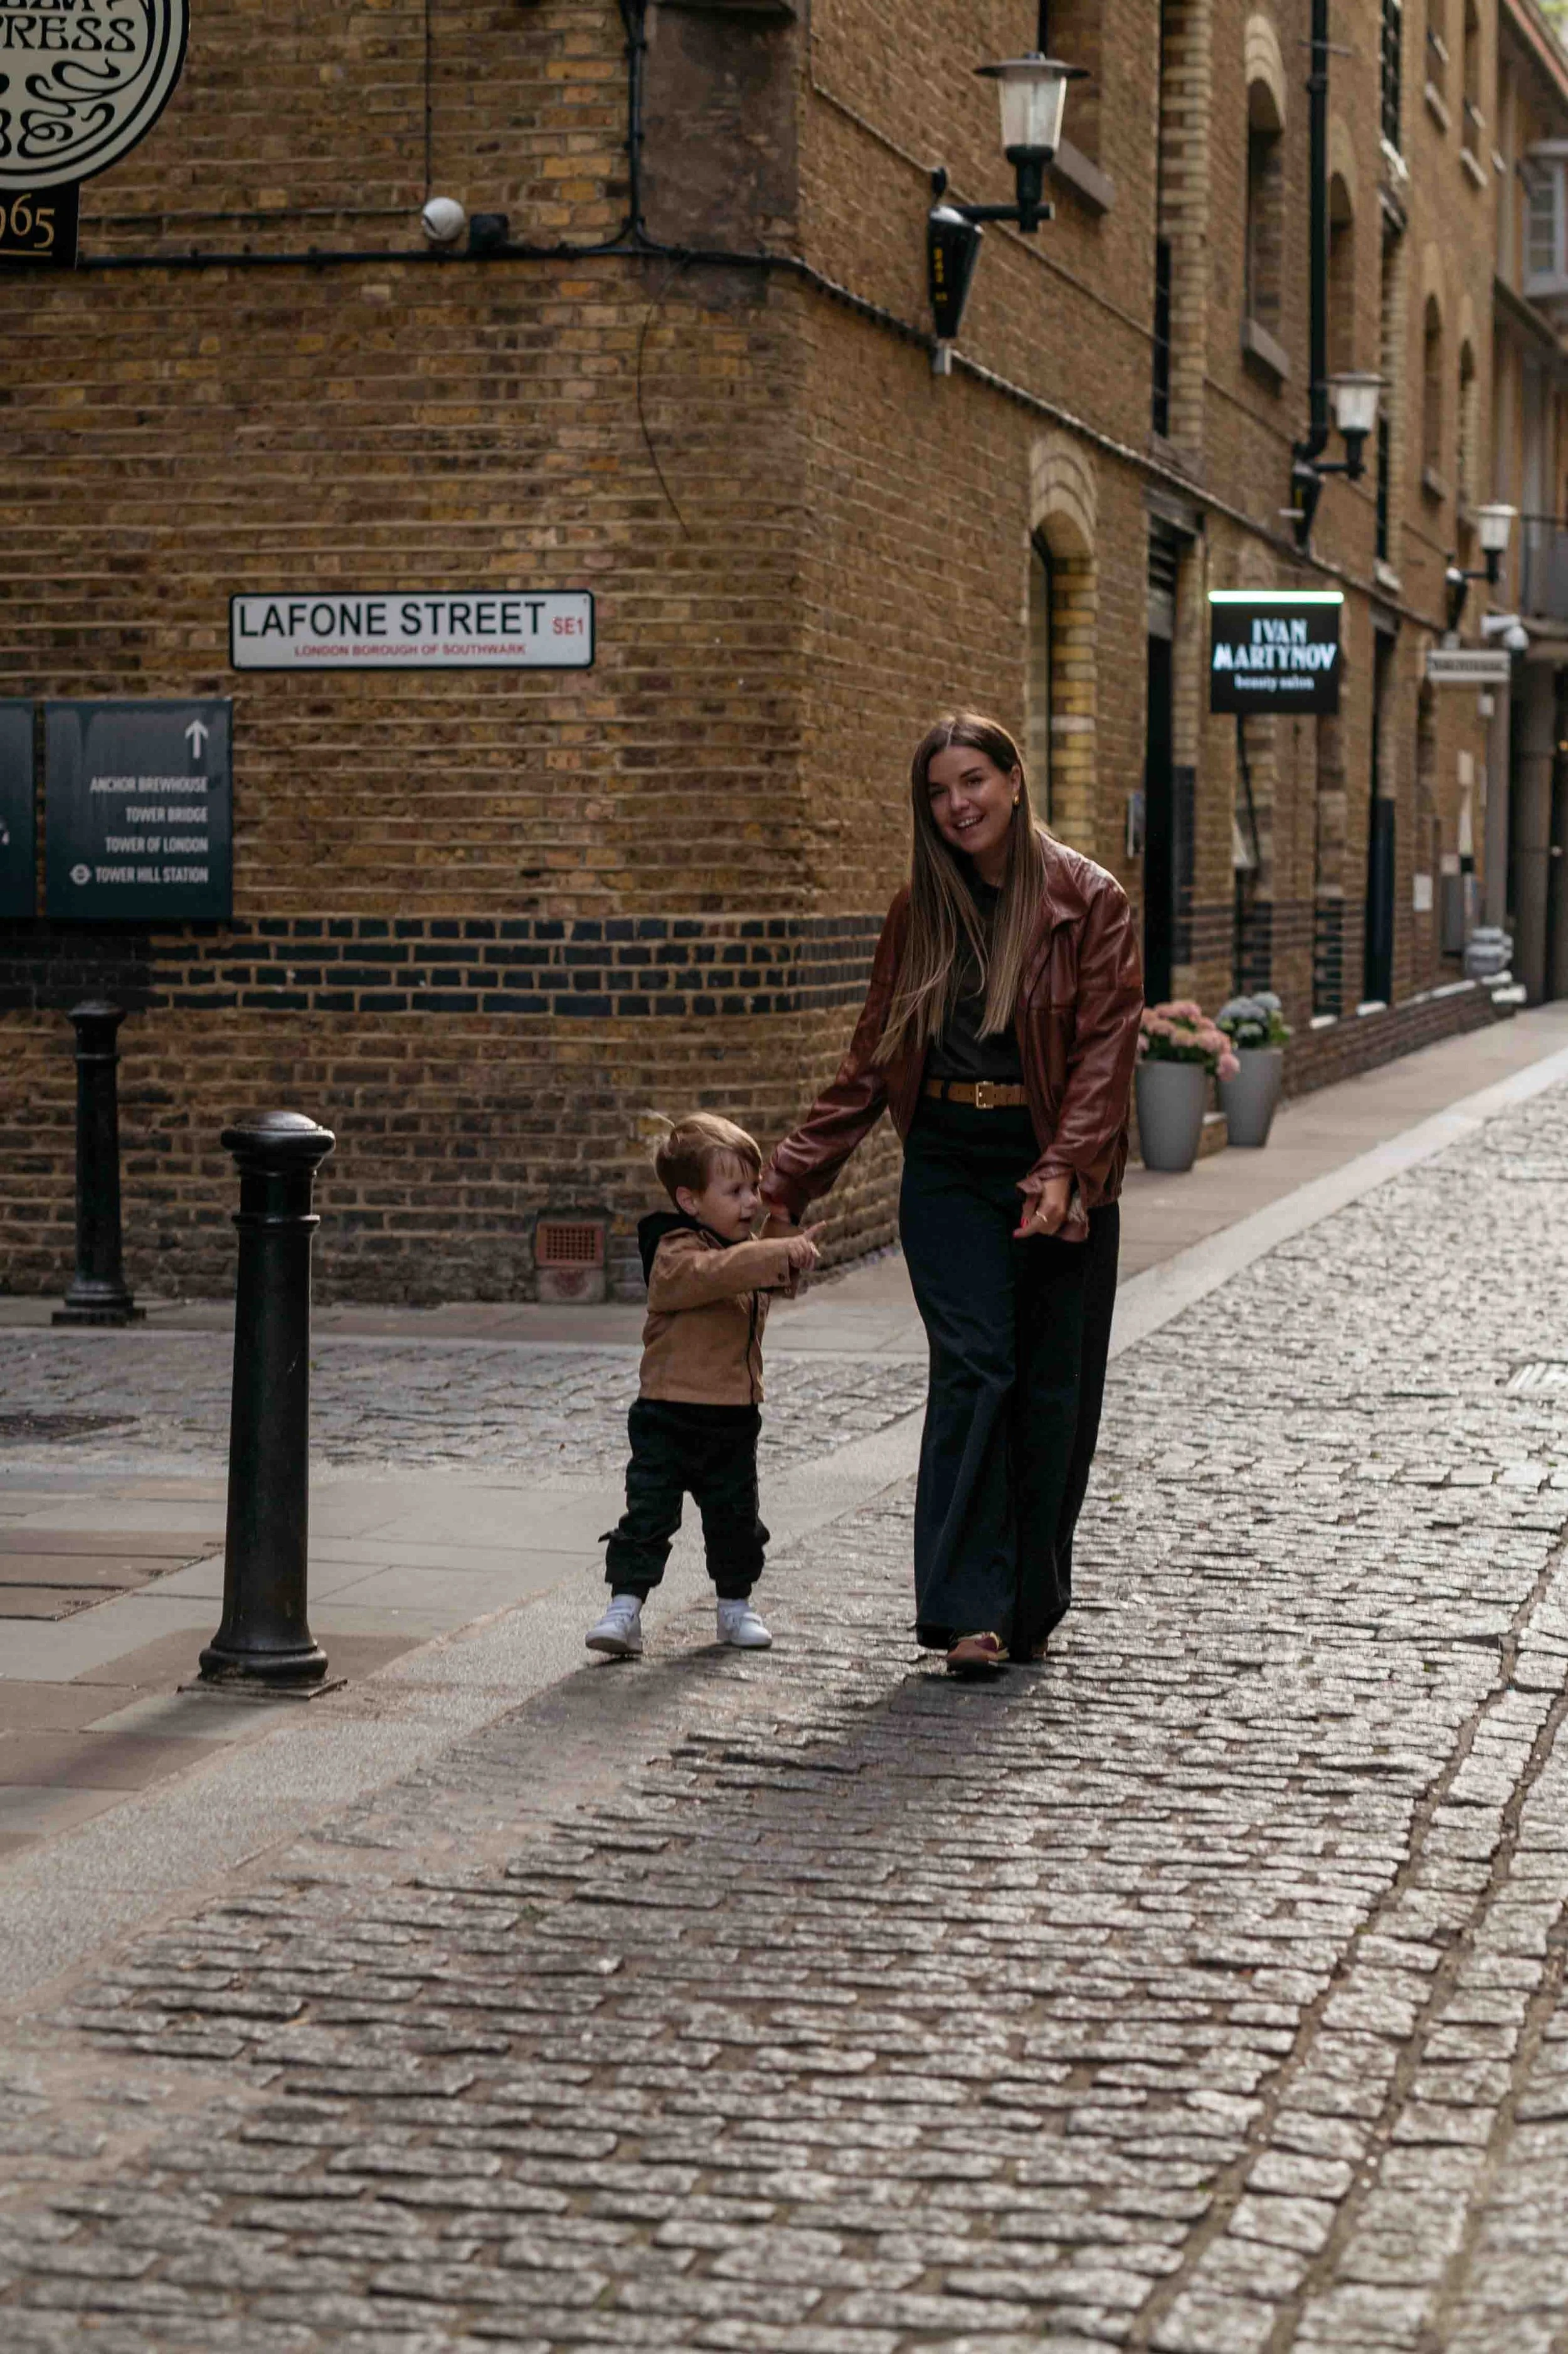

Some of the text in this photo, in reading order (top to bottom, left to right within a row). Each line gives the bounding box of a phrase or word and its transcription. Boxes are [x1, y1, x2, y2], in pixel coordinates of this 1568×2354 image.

[0, 14, 135, 51] RESS
[239, 602, 584, 637] LAFONE STREET SE1
[1251, 618, 1308, 644] IVAN
[294, 644, 526, 657] LONDON BOROUGH OF SOUTHWARK
[1212, 642, 1337, 670] MARTYNOV
[1234, 674, 1315, 692] beauty salon
[90, 775, 208, 793] ANCHOR BREWHOUSE
[125, 806, 208, 824] TOWER BRIDGE
[105, 836, 208, 854] TOWER OF LONDON
[96, 866, 208, 884] TOWER HILL STATION
